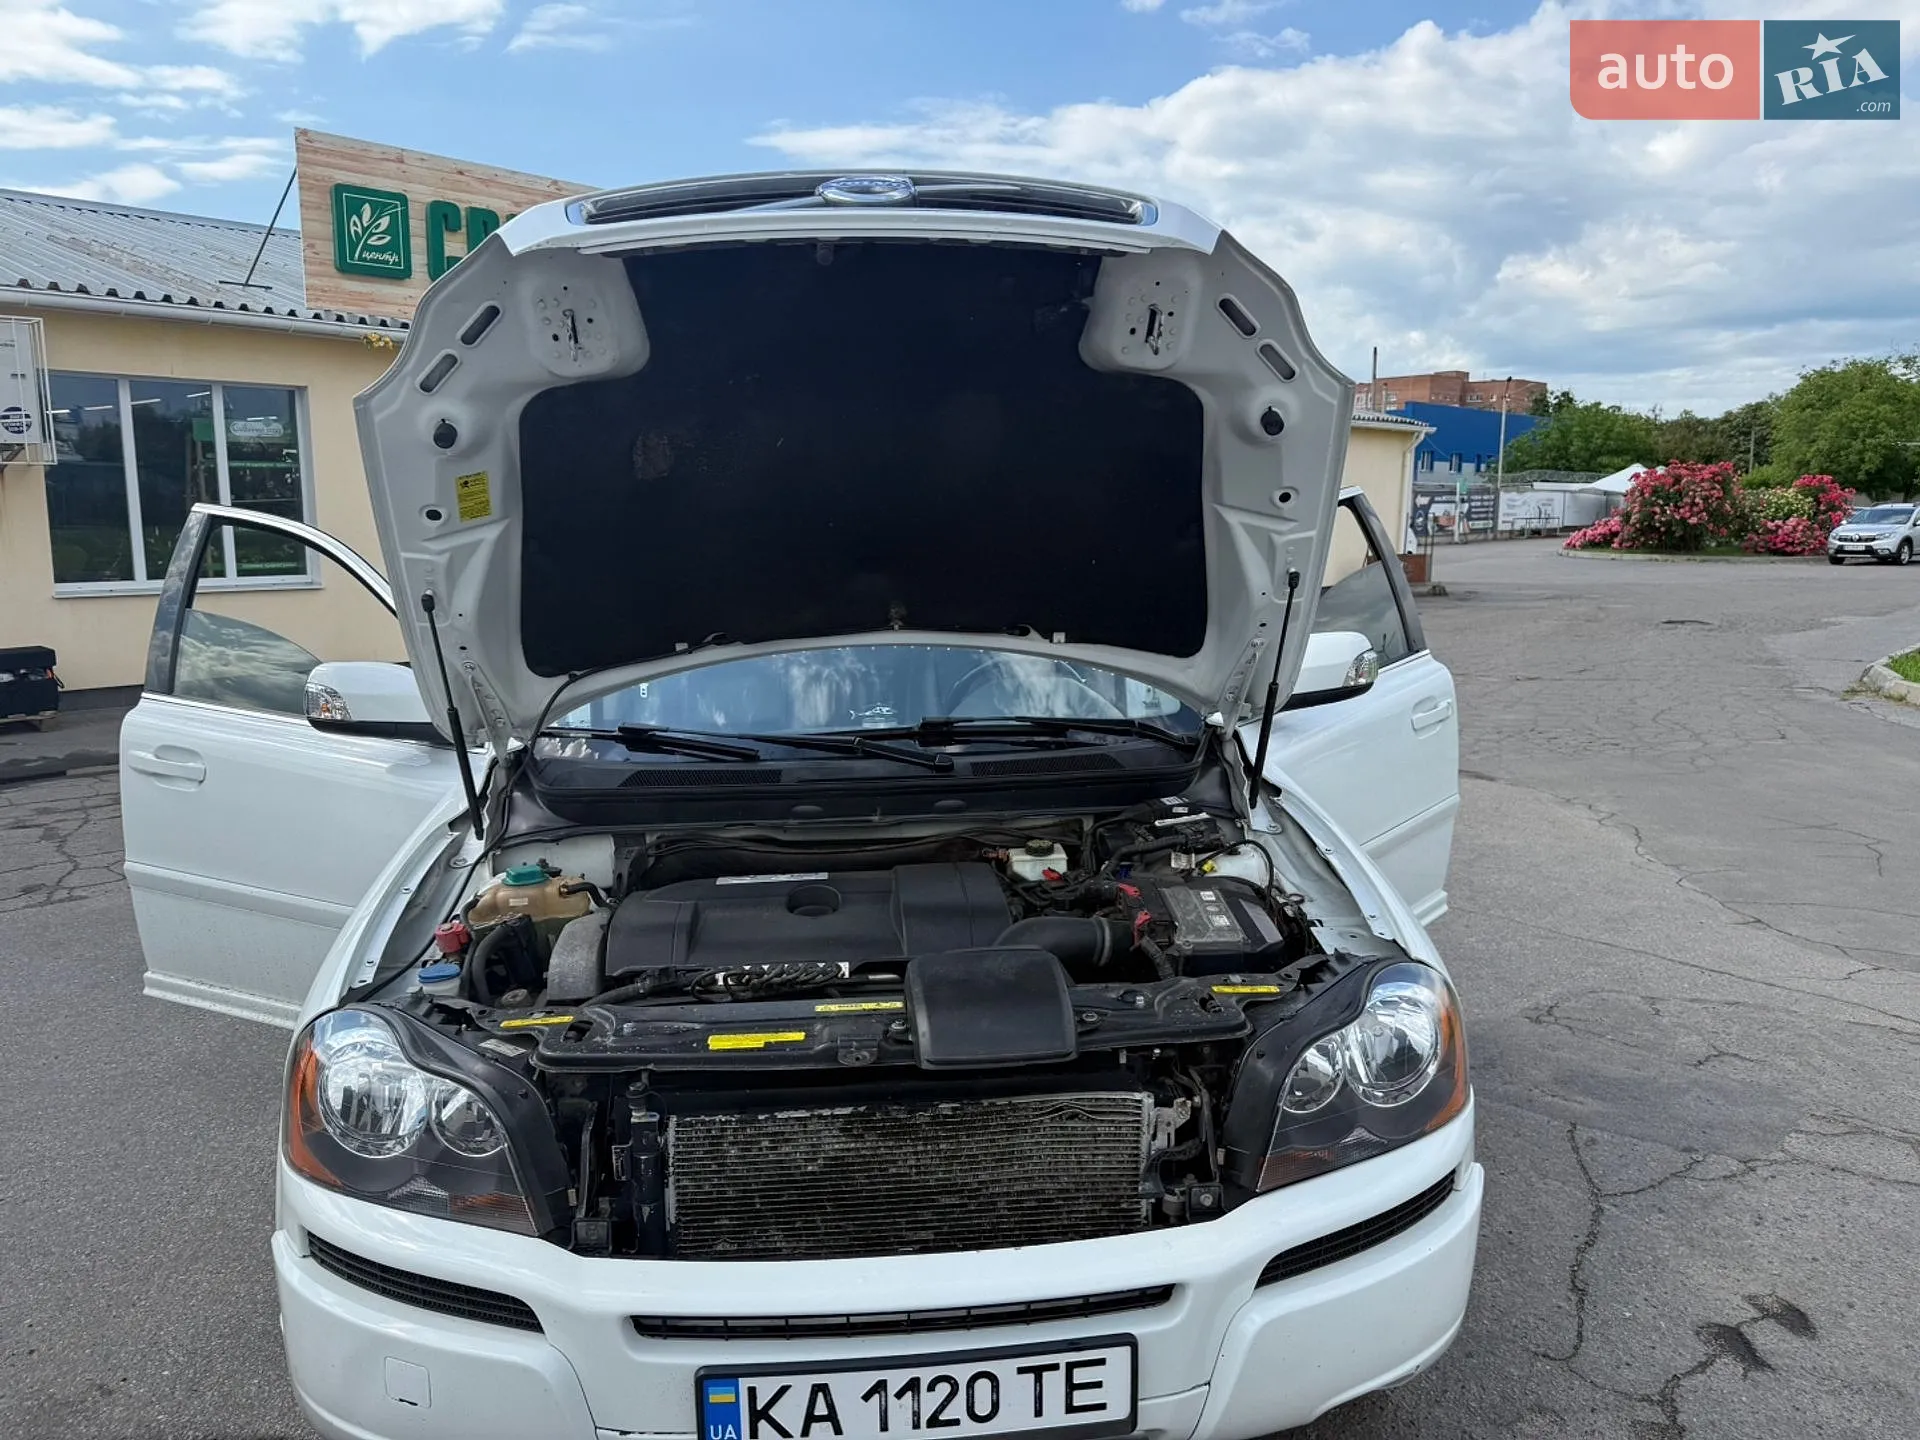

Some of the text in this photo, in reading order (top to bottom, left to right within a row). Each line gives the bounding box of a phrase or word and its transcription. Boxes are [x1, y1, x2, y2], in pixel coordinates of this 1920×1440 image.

[747, 1357, 1107, 1439] KA 1120 TE
[710, 1424, 738, 1440] UA
